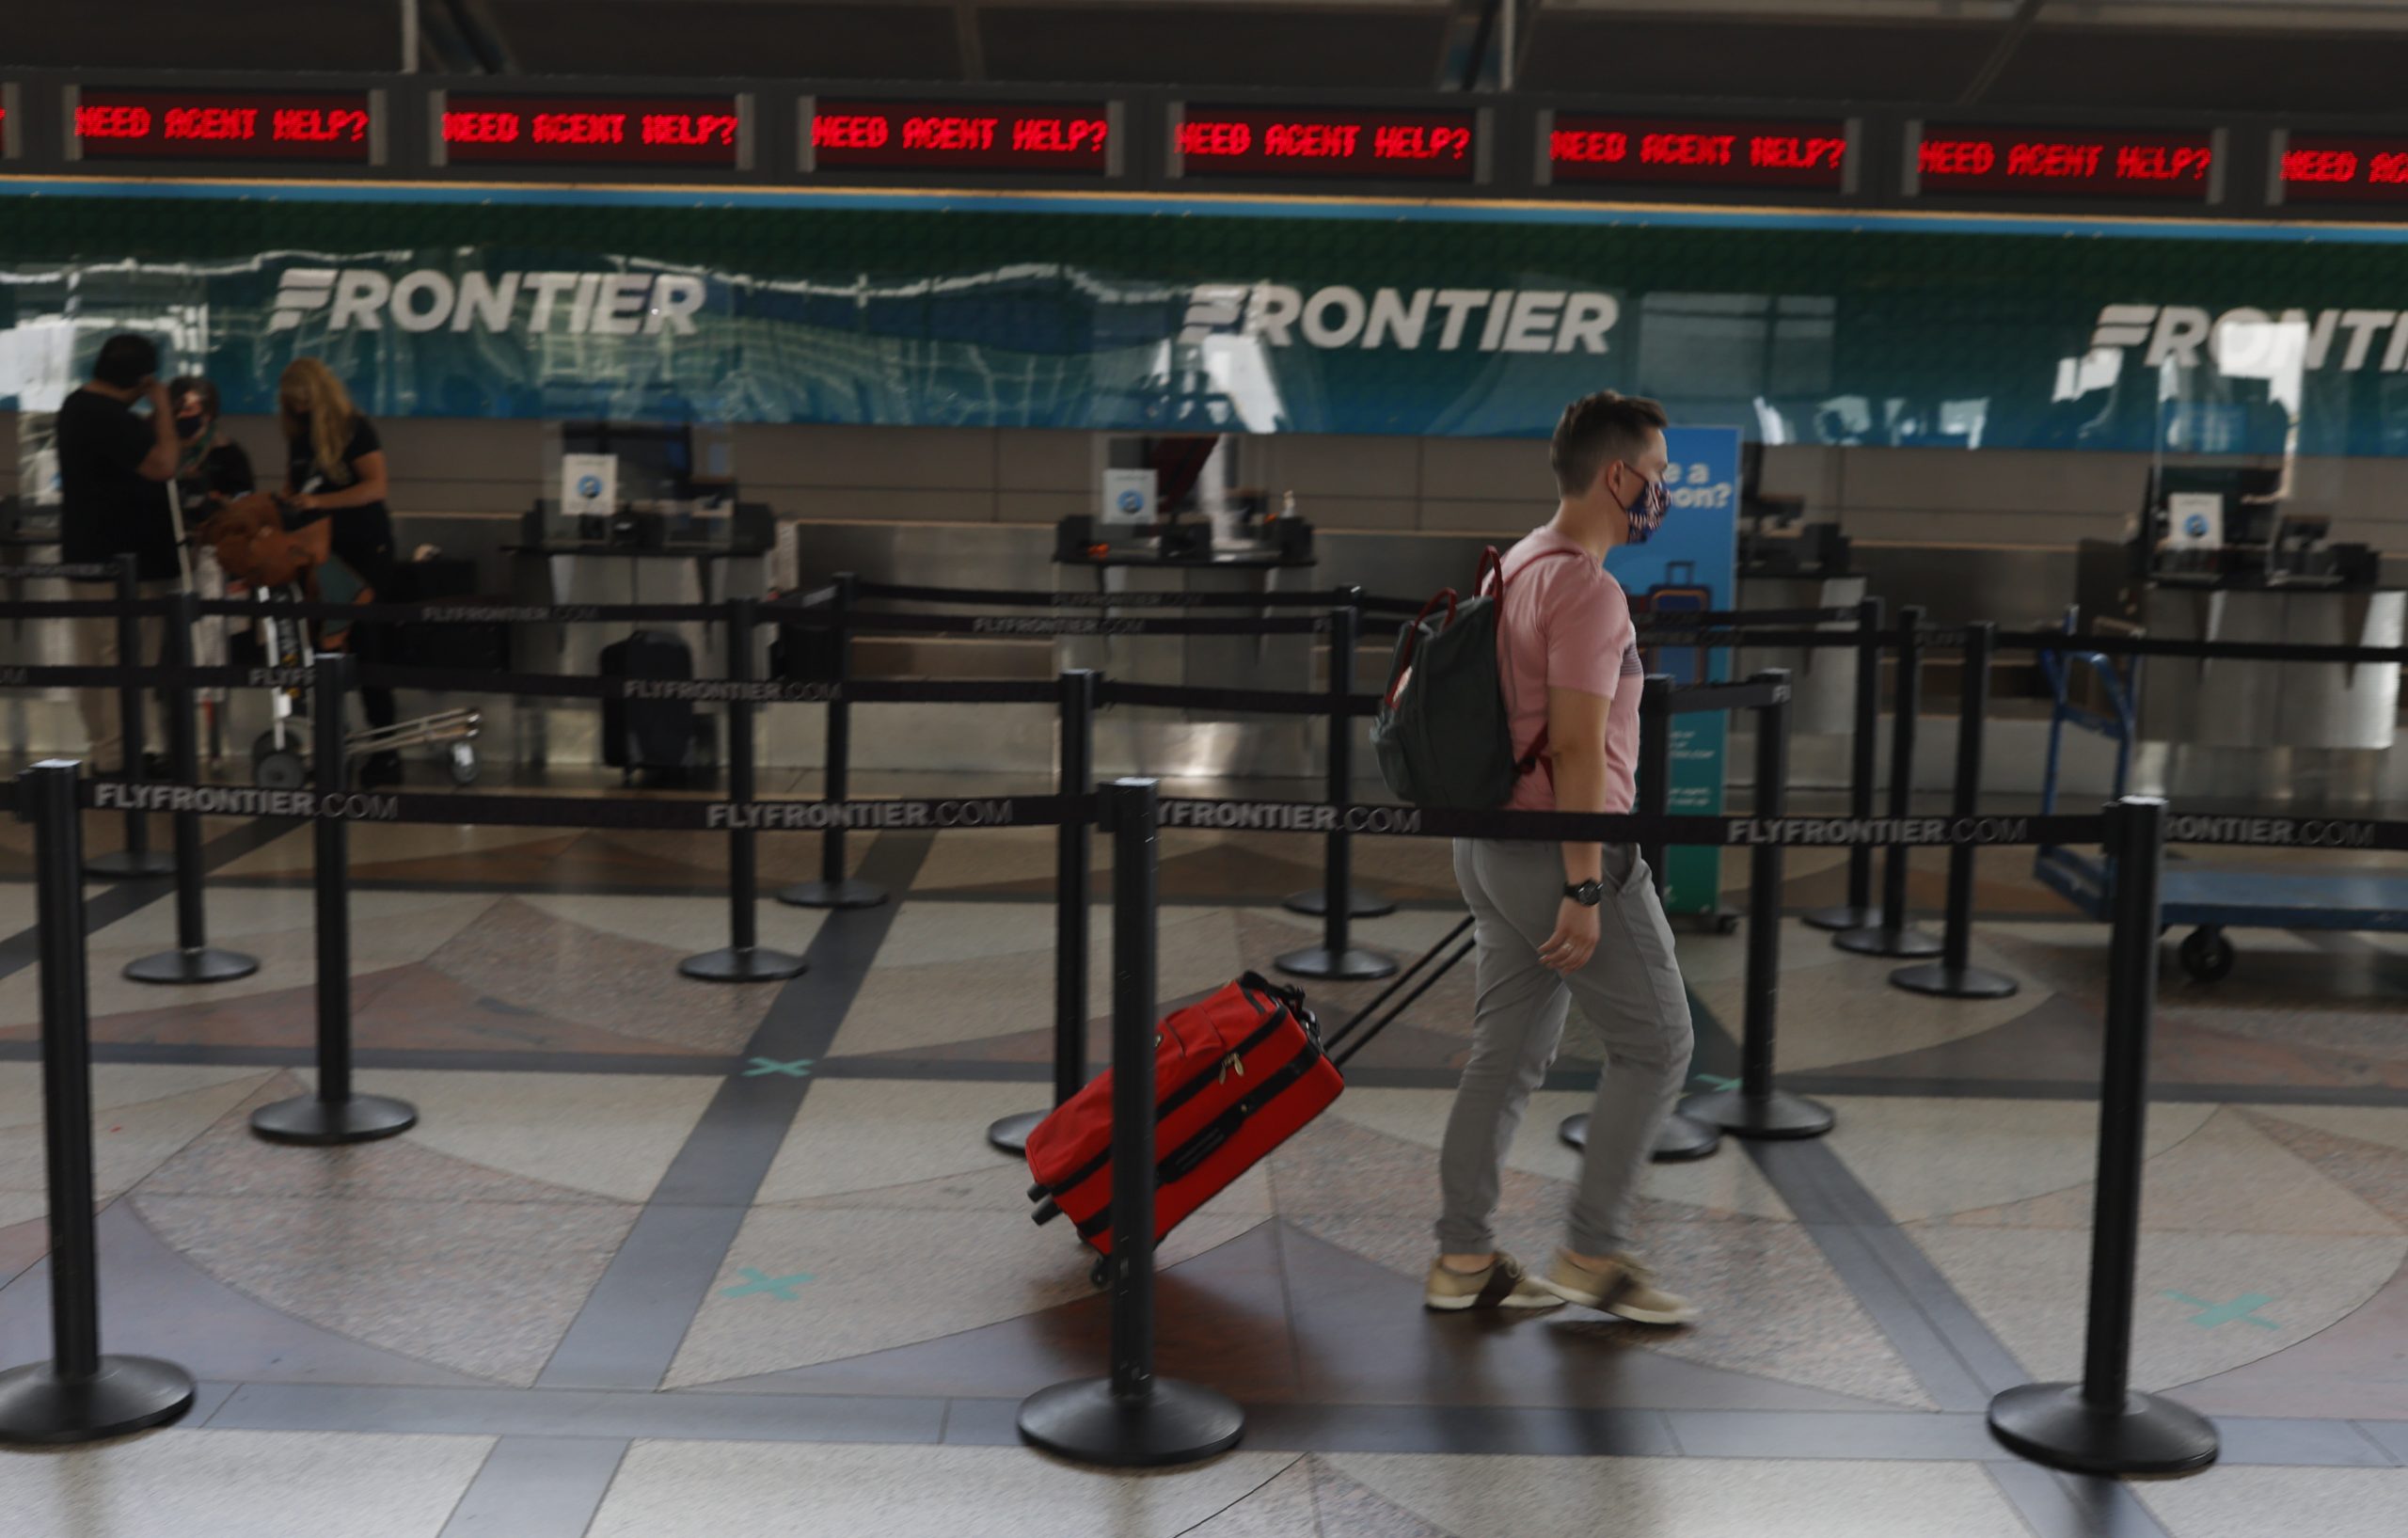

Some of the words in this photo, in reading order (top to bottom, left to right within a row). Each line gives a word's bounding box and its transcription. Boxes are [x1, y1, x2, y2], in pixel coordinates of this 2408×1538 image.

[75, 105, 151, 138] NEED
[165, 107, 258, 139] AGENT
[273, 109, 369, 141] HELP?
[442, 112, 519, 143] NEED
[532, 113, 626, 144] AGENT
[642, 115, 738, 146] HELP?
[811, 116, 888, 148] NEED
[903, 118, 998, 150] AGENT
[1013, 119, 1108, 152] HELP?
[1175, 122, 1251, 155] NEED
[1264, 124, 1360, 157] AGENT
[1374, 126, 1469, 159] HELP?
[1549, 131, 1626, 163] NEED
[1640, 134, 1735, 166] AGENT
[1751, 137, 1846, 168] HELP?
[1918, 142, 1994, 175] NEED
[2007, 144, 2102, 176] AGENT
[2117, 147, 2211, 179] HELP?
[2280, 151, 2358, 182] NEED
[264, 267, 706, 335] FRONTIER
[1178, 282, 1619, 354] FRONTIER
[1687, 462, 1710, 484] a
[1671, 483, 1732, 509] on?
[95, 783, 399, 820] FLYFRONTIER.COM
[706, 799, 1013, 829] FLYFRONTIER.COM
[1156, 799, 1421, 832] YFRONTIER.COM
[1727, 817, 2028, 845] FLYFRONTIER.COM
[2163, 814, 2376, 847] RONTIER.COM
